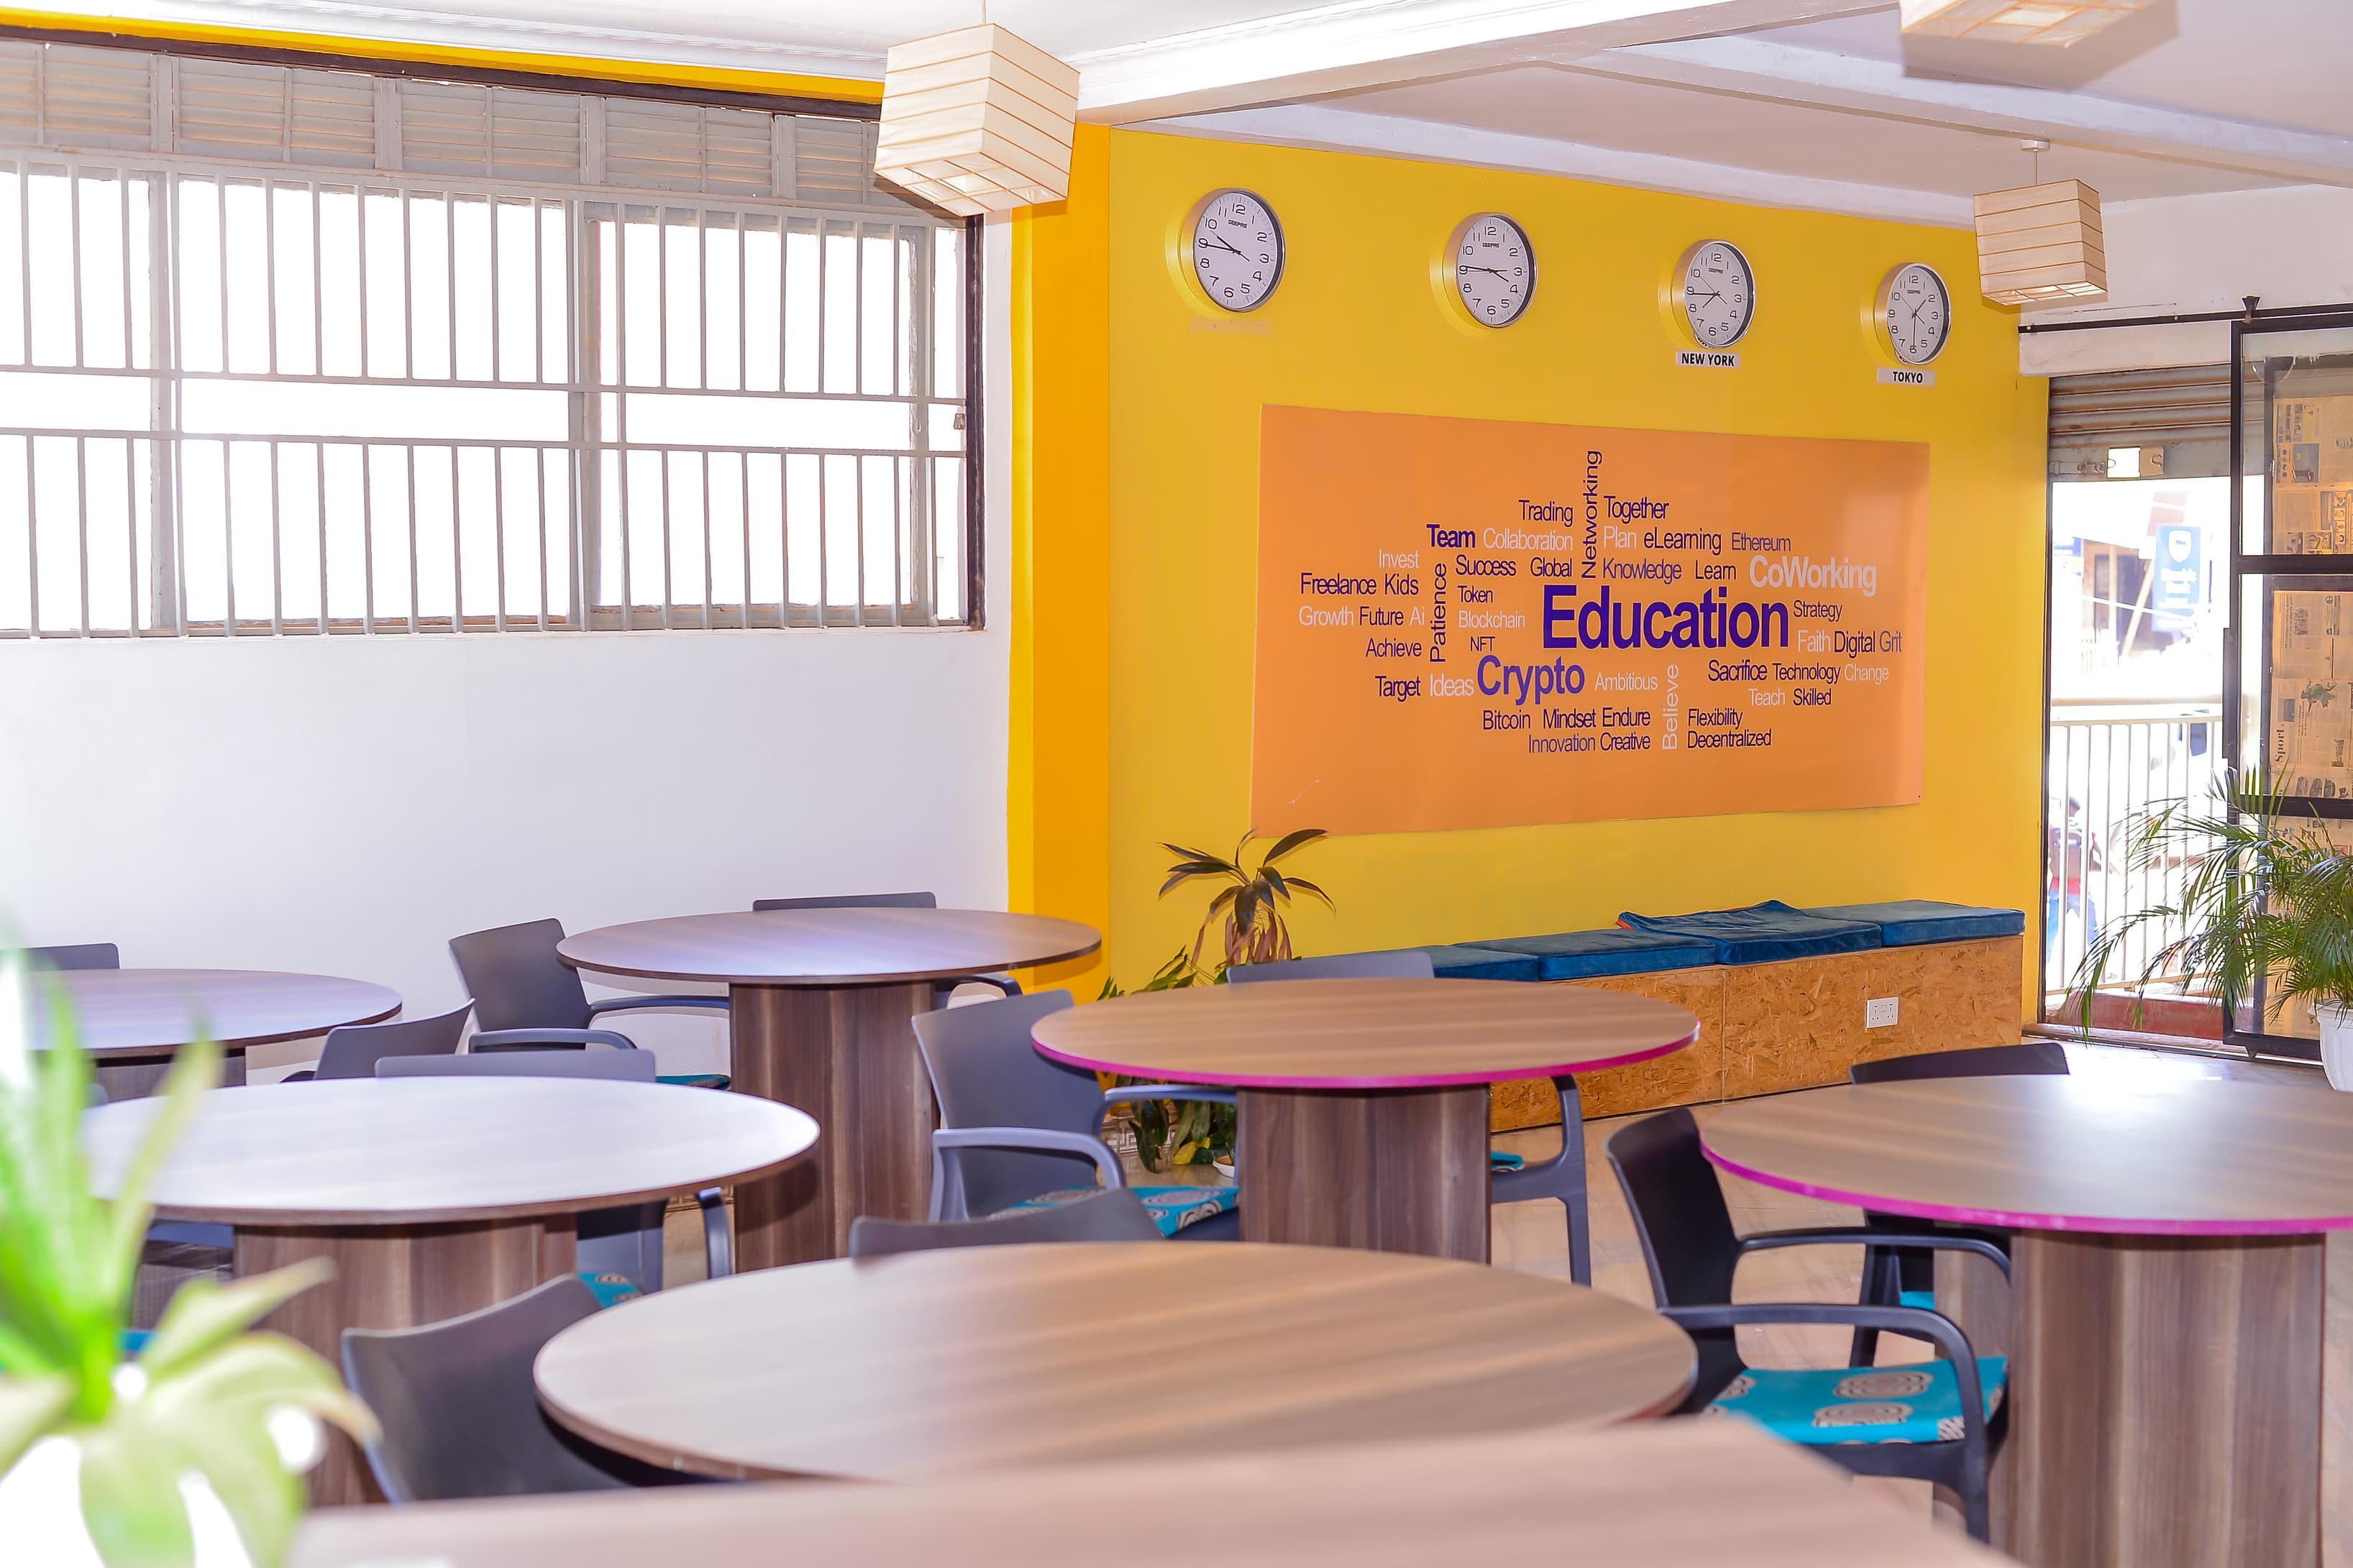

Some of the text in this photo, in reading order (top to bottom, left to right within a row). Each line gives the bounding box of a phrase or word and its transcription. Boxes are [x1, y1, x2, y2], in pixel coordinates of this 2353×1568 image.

[1219, 207, 1227, 217] 11
[1232, 203, 1246, 215] 12
[1205, 218, 1217, 229] 10
[1228, 219, 1248, 229] GEEPAS
[1484, 226, 1497, 235] 12
[1257, 231, 1267, 242] 2
[1474, 233, 1480, 242] 11
[1198, 238, 1208, 248] 9
[1463, 246, 1474, 255] 10
[1509, 248, 1518, 257] 2
[1200, 258, 1210, 267] 8
[1259, 253, 1269, 263] 3
[1711, 253, 1722, 262] 12
[1459, 265, 1468, 275] 9
[1514, 267, 1522, 276] 3
[1691, 268, 1700, 278] 10
[1210, 275, 1219, 286] 7
[1253, 271, 1262, 281] 4
[1732, 275, 1739, 284] 2
[1224, 288, 1234, 298] 6
[1241, 284, 1251, 293] 5
[1463, 283, 1471, 293] 8
[1510, 285, 1518, 294] 4
[1687, 286, 1694, 295] 9
[1735, 294, 1742, 303] 3
[1891, 292, 1900, 301] 10
[1473, 298, 1481, 308] 7
[1501, 299, 1509, 308] 5
[1487, 306, 1496, 315] 6
[1730, 311, 1737, 319] 4
[1697, 318, 1704, 327] 7
[1709, 327, 1717, 336] 6
[1910, 345, 1916, 354] 6
[1682, 353, 1735, 366] NEW YORK
[1893, 372, 1923, 383] TOKYO
[1518, 499, 1573, 527] Trading
[1581, 451, 1602, 579] Networking
[1604, 495, 1669, 524] Together
[1427, 523, 1573, 551] Team Collaboration
[1603, 525, 1791, 556] Plan eLearning Ethereum
[1379, 548, 1420, 569] Invest
[1455, 554, 1572, 577] Success Global
[1602, 557, 1737, 584] Knowledge Learn
[1749, 555, 1877, 597] CoWorking
[1300, 572, 1420, 596] Freelance Kids
[1458, 585, 1494, 603] Token
[1298, 605, 1425, 626] Growth Future Ai
[1430, 563, 1447, 663] Patience
[1543, 584, 1789, 649] Education
[1793, 600, 1843, 623] Strategy
[1458, 610, 1525, 629] Blockchain
[1366, 638, 1422, 658] Achieve
[1470, 636, 1495, 652] NFT
[1797, 629, 1903, 659] Faith Digital Grit
[1708, 659, 1889, 684] Sacrifice Technology Change
[1430, 674, 1474, 697] Ideas
[1476, 654, 1586, 706] Crypto
[1594, 672, 1658, 692] Ambitious
[1375, 675, 1421, 702] Target
[1748, 688, 1832, 706] Teach Skilled
[1663, 664, 1679, 750] Believe
[1482, 707, 1650, 730] Bitcoin Mindset Endure
[1688, 707, 1743, 730] Flexibility
[1528, 733, 1650, 753] Innovation Creative
[1687, 729, 1772, 749] Decentralized
[2275, 728, 2286, 763] Sport
